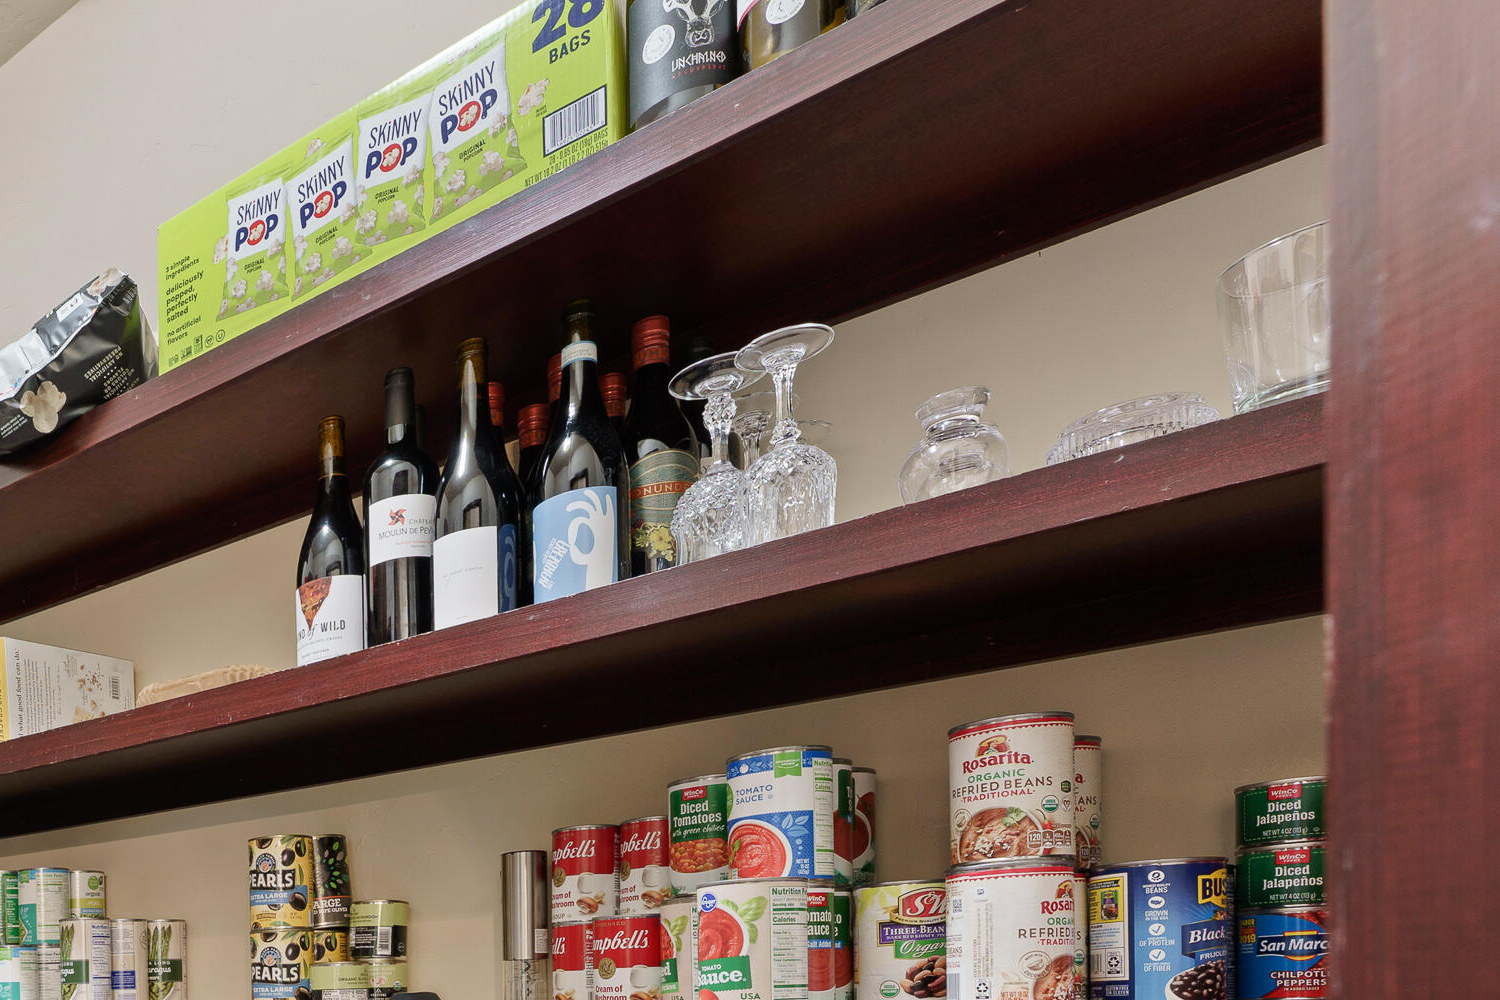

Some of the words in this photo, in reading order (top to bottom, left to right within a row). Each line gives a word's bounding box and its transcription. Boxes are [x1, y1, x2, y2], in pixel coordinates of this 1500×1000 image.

[549, 29, 591, 64] BAGS
[441, 88, 498, 144] POP
[365, 136, 418, 179] POP
[300, 180, 347, 229] POP
[235, 213, 279, 252] POP
[165, 271, 204, 296] deliciously
[166, 293, 198, 316] perfectly
[166, 306, 189, 323] salted
[378, 527, 408, 541] MOULIN
[409, 527, 419, 535] DE
[320, 619, 346, 633] WILD
[16, 694, 24, 714] good
[962, 750, 1033, 775] Rosarita
[967, 767, 1026, 784] ORGANIC
[684, 788, 705, 796] WinCo
[735, 784, 773, 796] TOMATO
[952, 781, 1001, 799] REFRIED
[1003, 775, 1053, 791] BEANS
[1270, 788, 1298, 797] WinCo
[735, 793, 764, 805] SAUCE
[680, 800, 709, 815] Diced
[1267, 800, 1302, 813] Diced
[673, 811, 722, 828] Tomatoes
[1256, 811, 1315, 826] Jalapeños
[1029, 832, 1041, 842] 120
[1278, 853, 1306, 861] WinCo
[1275, 865, 1310, 877] Diced
[1145, 885, 1168, 894] BEANS
[1263, 877, 1323, 890] Jalapeños
[264, 891, 288, 899] LARGE
[771, 887, 801, 896] Nutrition
[772, 915, 797, 924] Calories
[1145, 909, 1169, 917] GROWN
[883, 924, 945, 937] THREE-BEAN
[1188, 927, 1226, 945] Black
[1139, 939, 1147, 947] OF
[1147, 938, 1175, 947] PROTEIN
[1260, 939, 1286, 953] San
[1143, 965, 1151, 973] OF
[1152, 964, 1171, 973] FIBER
[1276, 978, 1327, 987] PEPPERS
